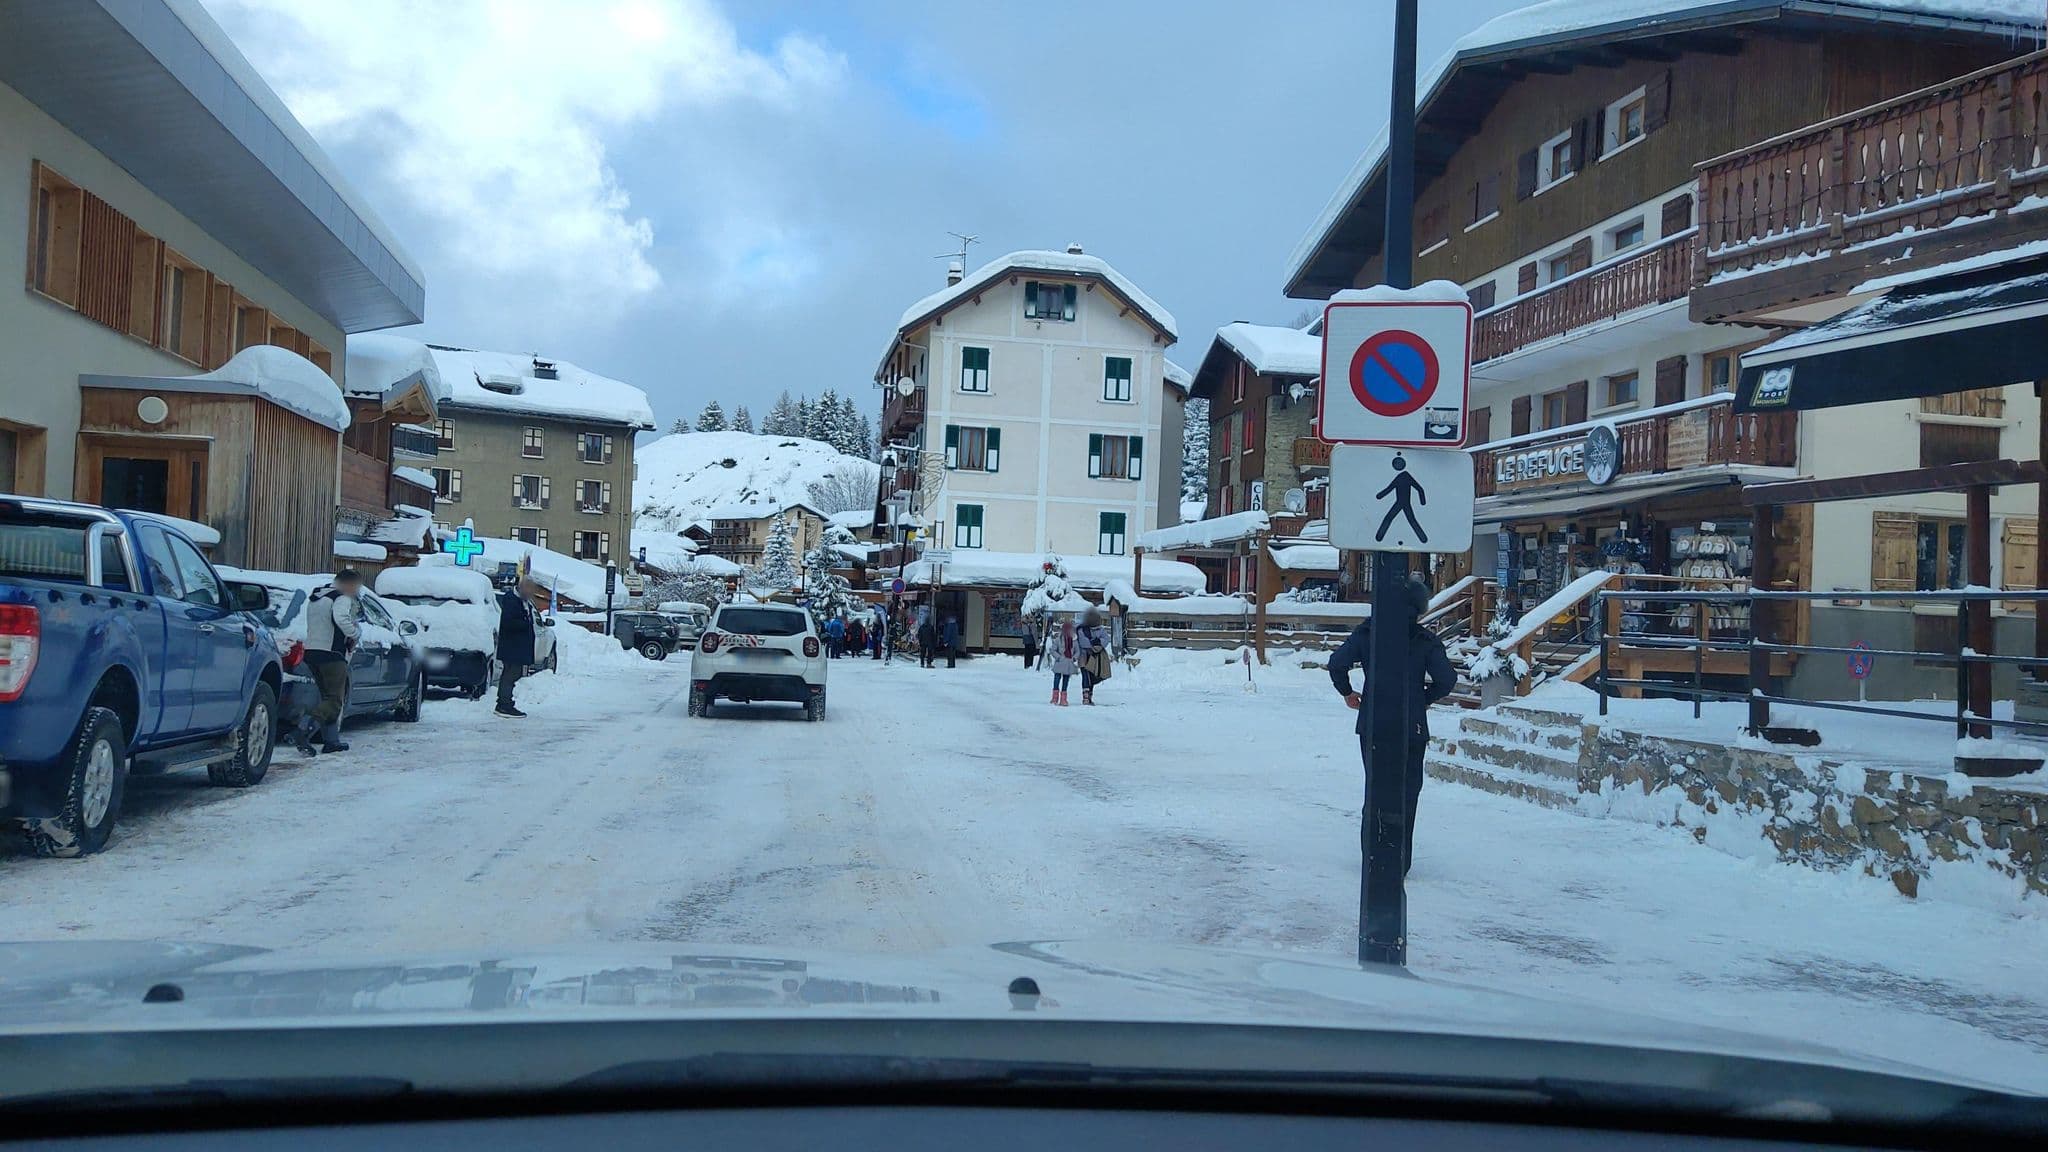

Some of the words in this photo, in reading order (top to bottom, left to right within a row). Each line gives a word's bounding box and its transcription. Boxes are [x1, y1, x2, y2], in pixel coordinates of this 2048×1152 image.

[1761, 368, 1792, 391] GO
[1496, 456, 1516, 484] LE
[1516, 443, 1585, 481] REFUGE
[725, 637, 750, 645] SERVICE
